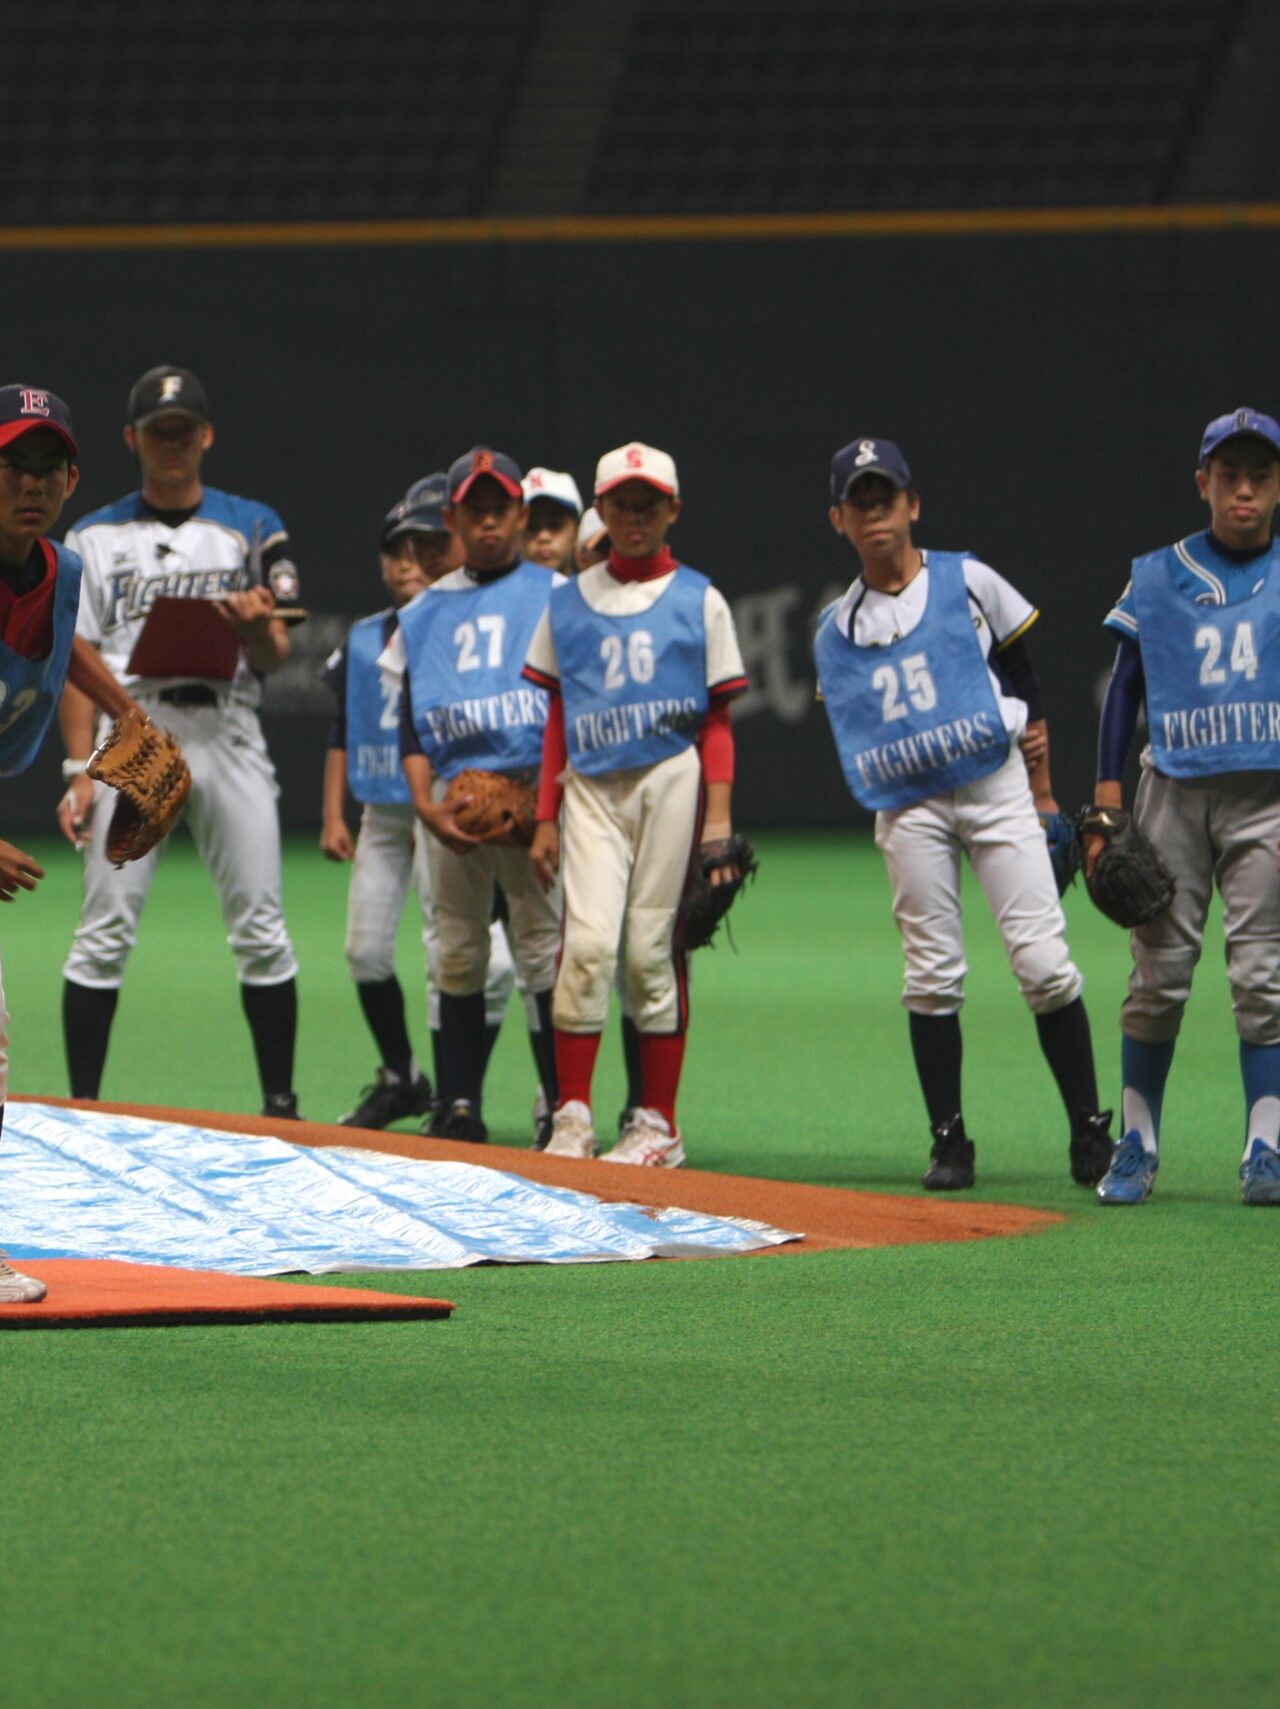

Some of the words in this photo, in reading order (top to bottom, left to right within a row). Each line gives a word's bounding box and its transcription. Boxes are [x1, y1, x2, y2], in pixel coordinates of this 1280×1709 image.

[19, 387, 50, 417] E
[159, 375, 183, 401] F
[853, 439, 879, 467] S
[454, 614, 505, 673] 27
[600, 630, 655, 690] 26
[1194, 622, 1258, 686] 24
[872, 652, 938, 723] 25
[424, 688, 549, 746] FIGHTERS
[574, 697, 697, 753] FIGHTERS
[853, 710, 996, 788] FIGHTERS
